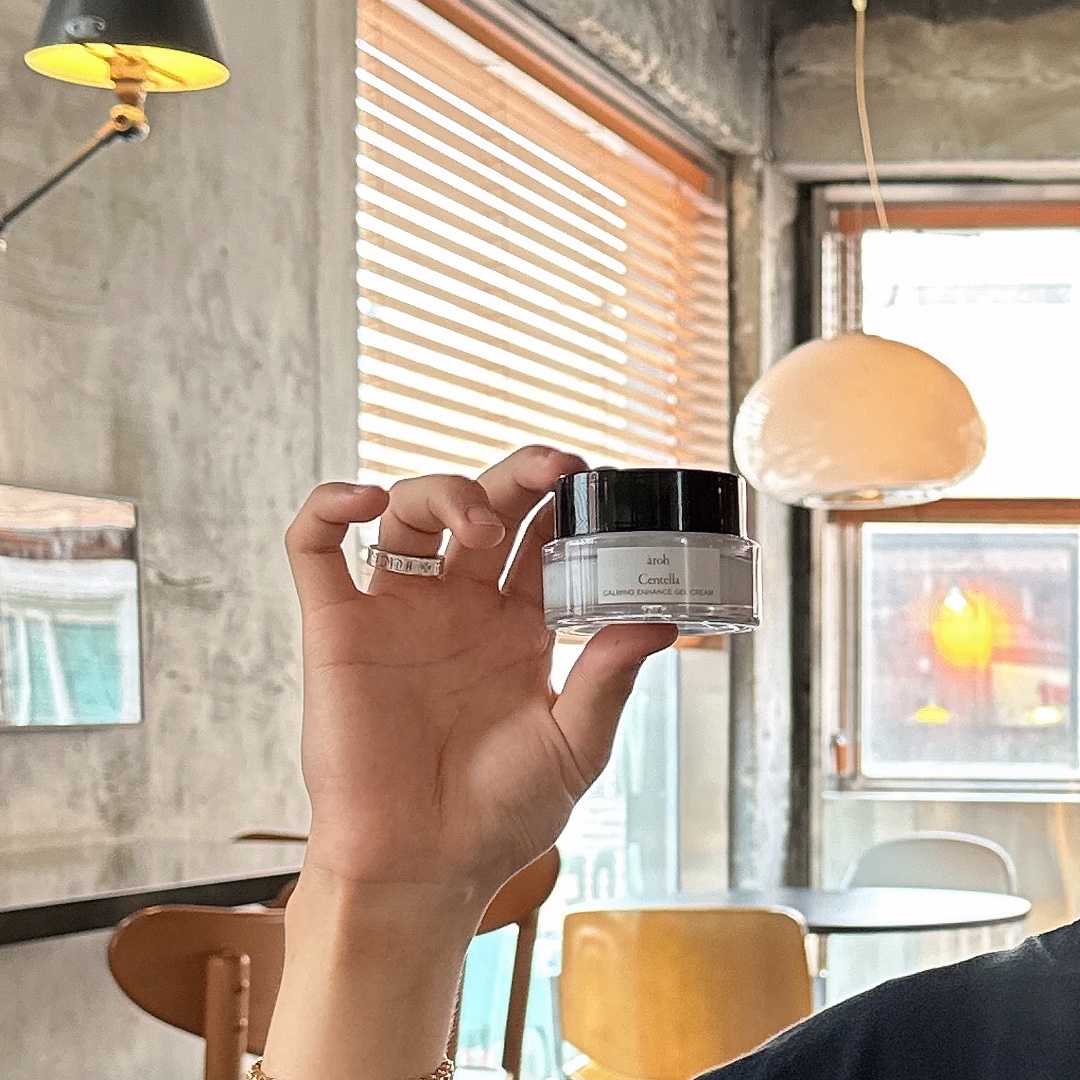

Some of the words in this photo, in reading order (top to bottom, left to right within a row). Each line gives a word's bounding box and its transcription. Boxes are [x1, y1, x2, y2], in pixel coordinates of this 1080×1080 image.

[638, 573, 680, 585] Centella
[603, 588, 634, 597] CALMING
[637, 588, 673, 596] ENHANCE
[690, 588, 714, 597] CREAM
